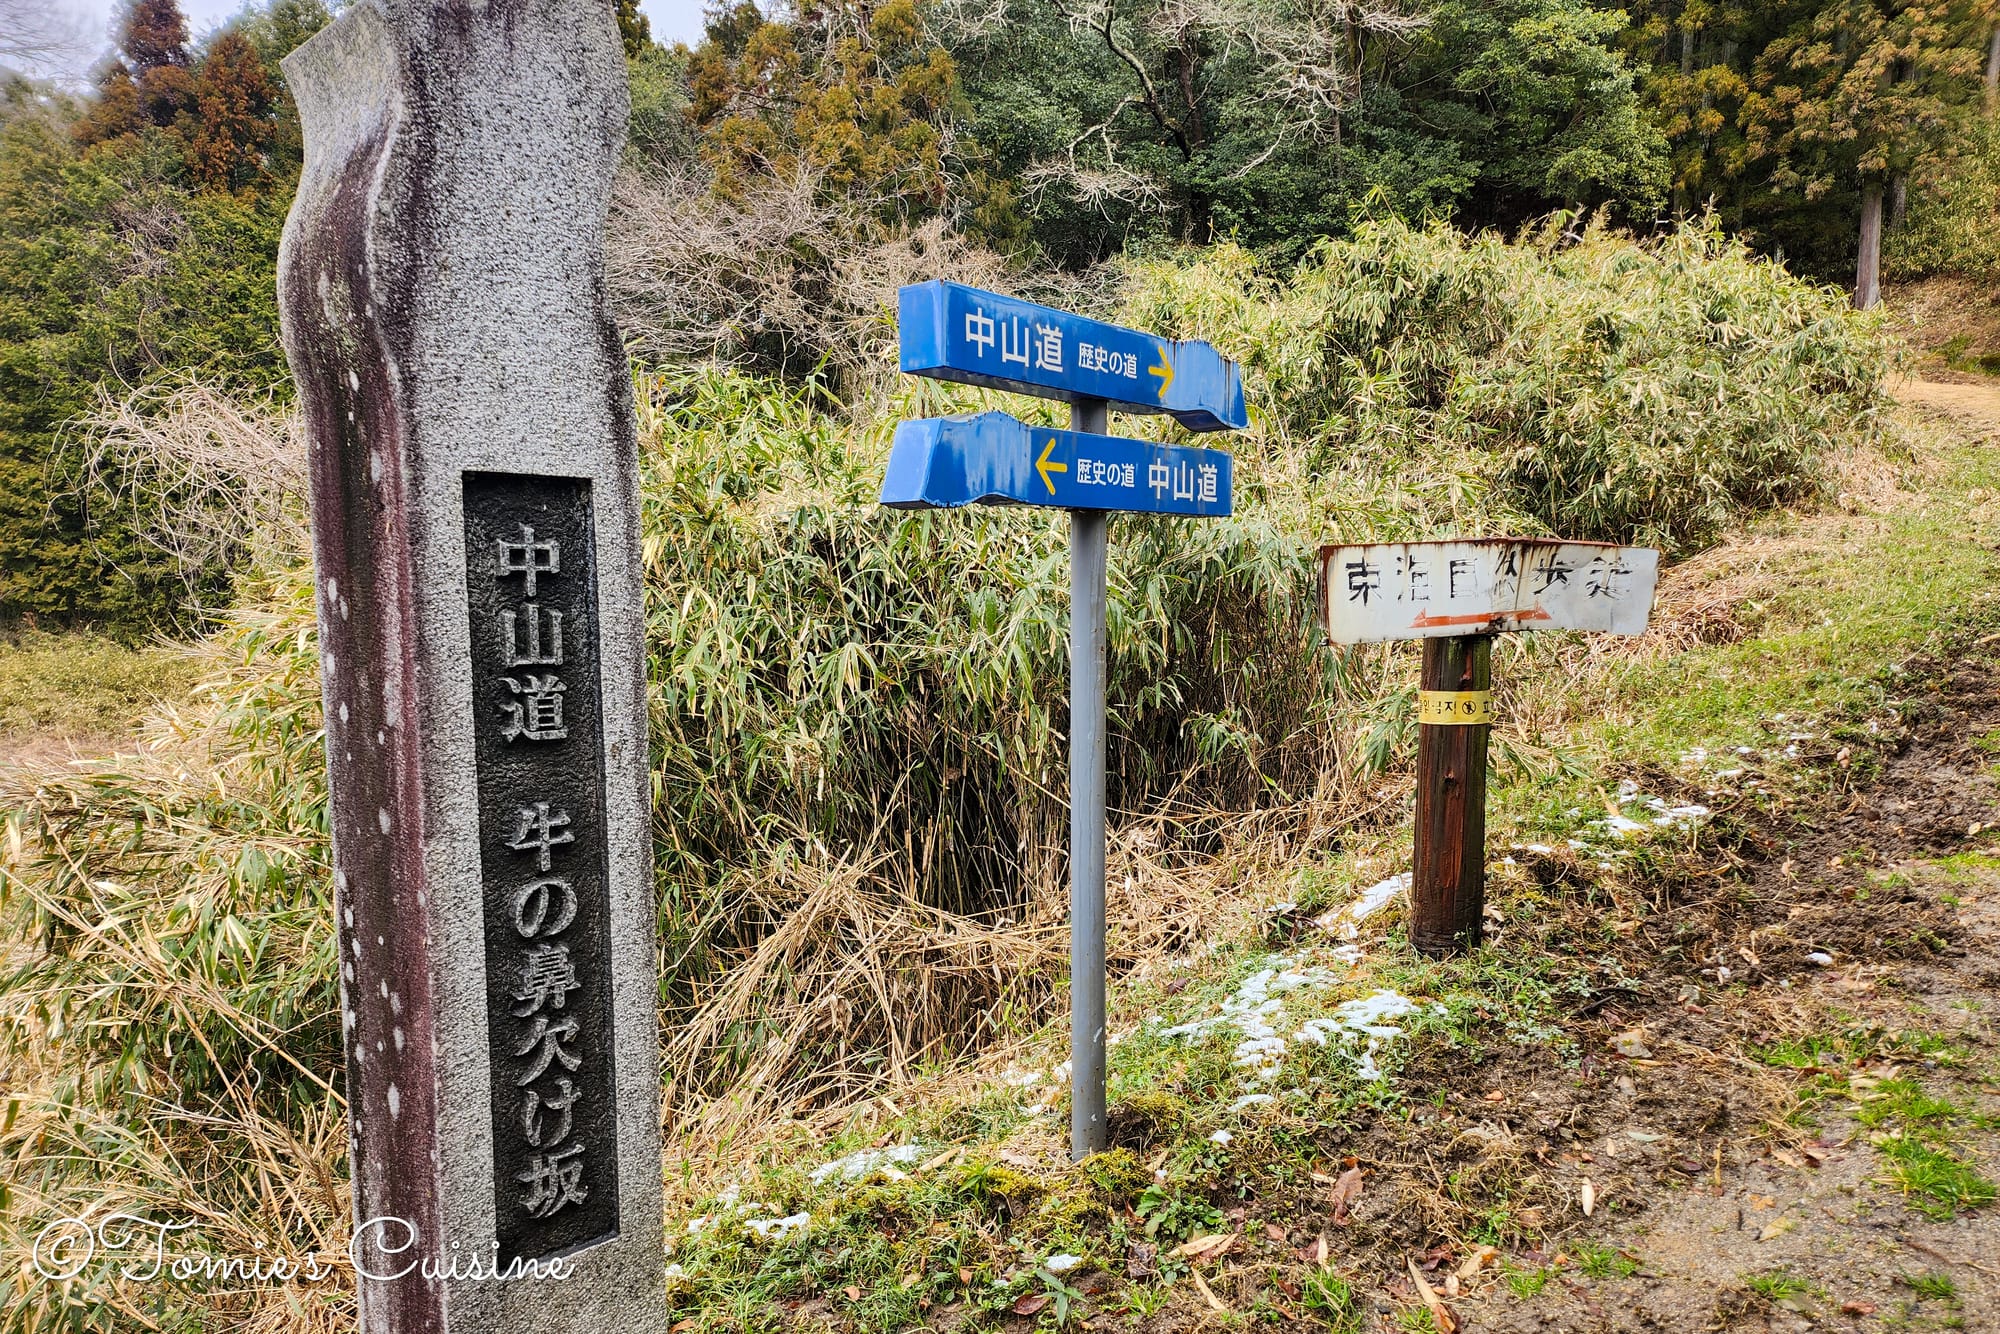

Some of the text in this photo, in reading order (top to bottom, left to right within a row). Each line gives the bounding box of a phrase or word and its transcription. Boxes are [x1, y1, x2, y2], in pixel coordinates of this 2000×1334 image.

[964, 307, 1138, 379] 中山道 歴史の道
[1076, 457, 1218, 503] 歴史の道 中山道
[496, 522, 588, 1219] 中山道 牛の鼻欠け坂
